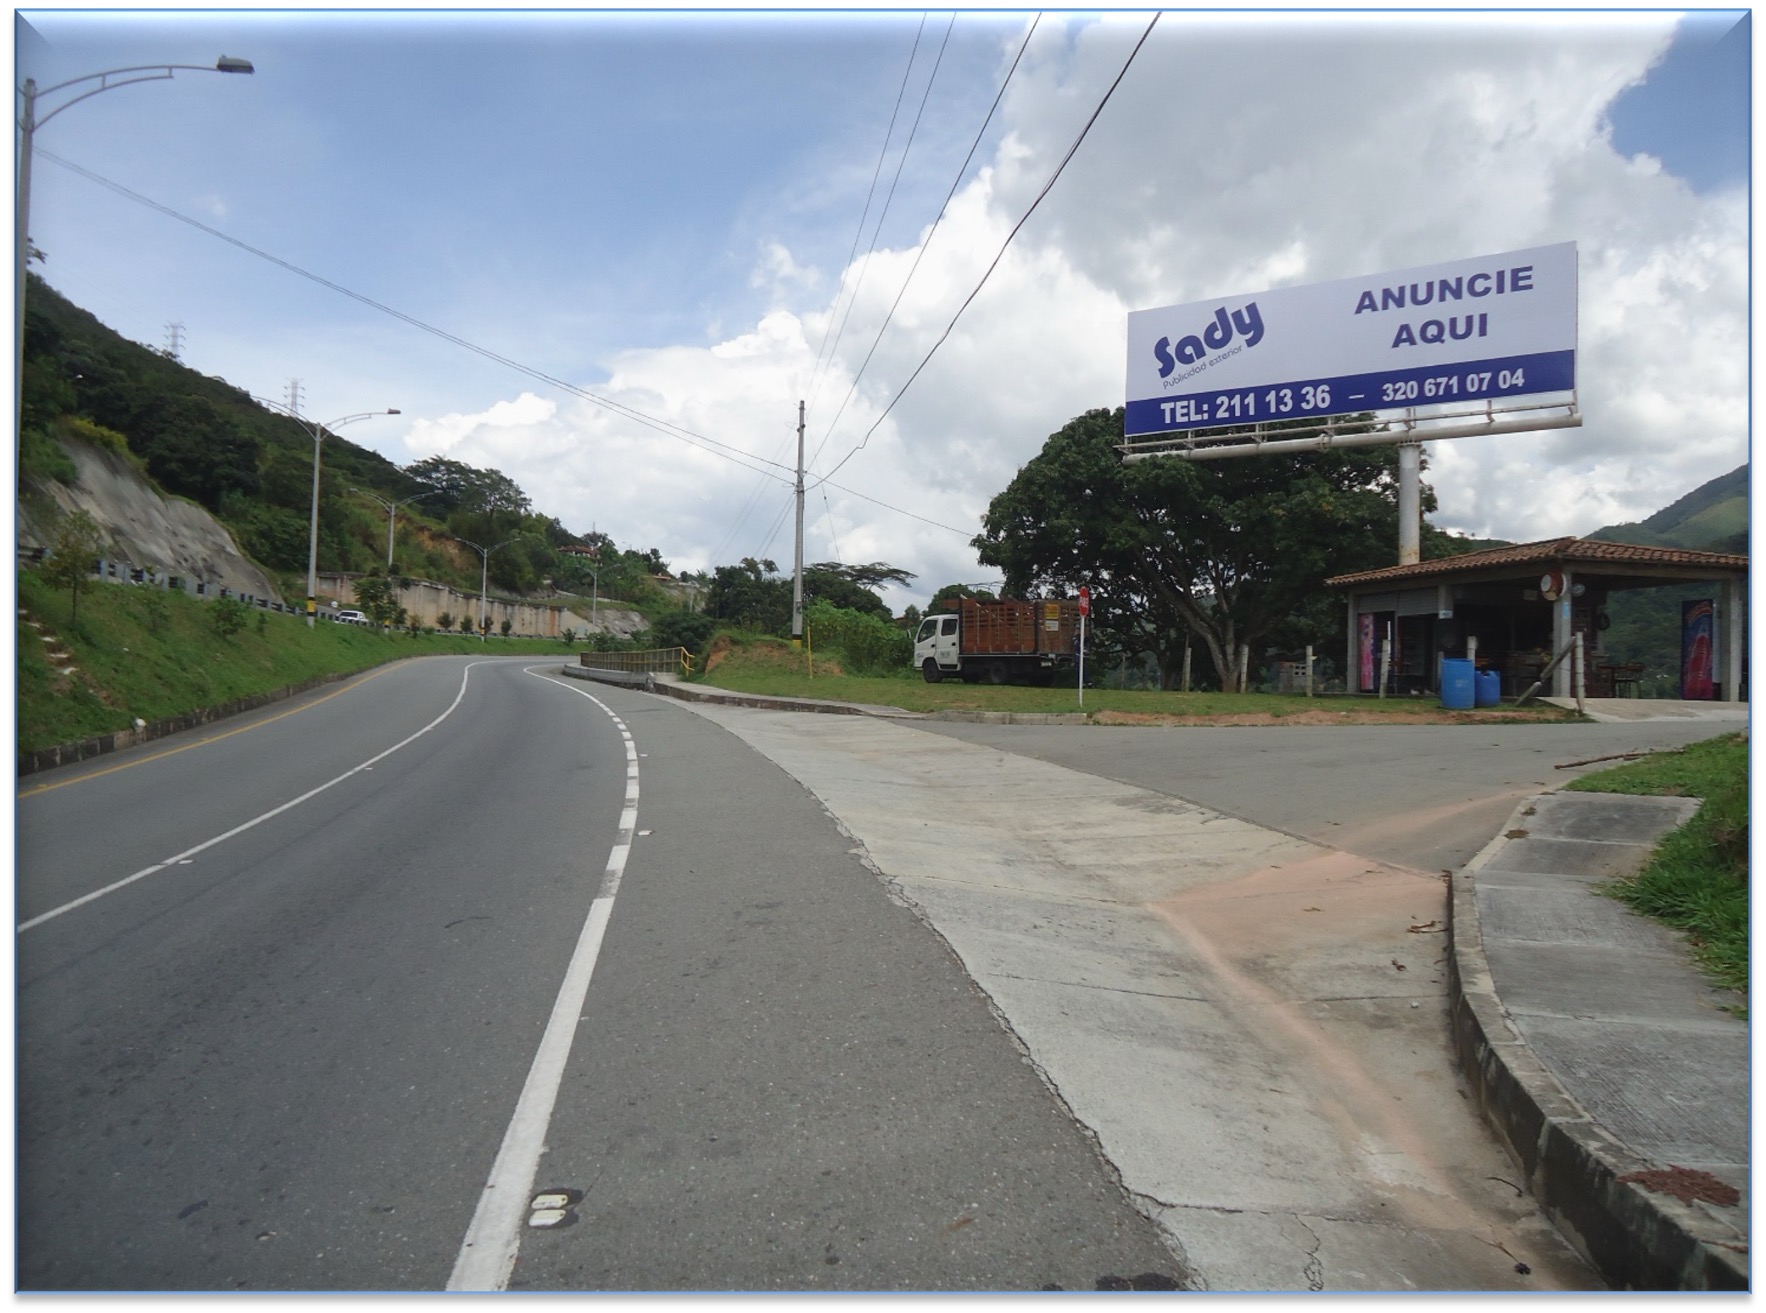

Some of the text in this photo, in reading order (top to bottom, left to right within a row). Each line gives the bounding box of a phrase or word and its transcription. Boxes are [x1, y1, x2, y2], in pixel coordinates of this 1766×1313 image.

[1354, 265, 1534, 315] ANUNCIE
[1154, 301, 1265, 379] Sady
[1391, 312, 1489, 349] AQUI
[1162, 344, 1243, 390] Publicidad exterior
[1160, 399, 1209, 424] TEL:
[1215, 393, 1256, 419] 211
[1265, 388, 1294, 413] 13
[1300, 384, 1332, 410] 36
[1382, 380, 1419, 402] 320
[1424, 375, 1459, 397] 671
[1466, 372, 1493, 393] 07
[1498, 367, 1526, 389] 04
